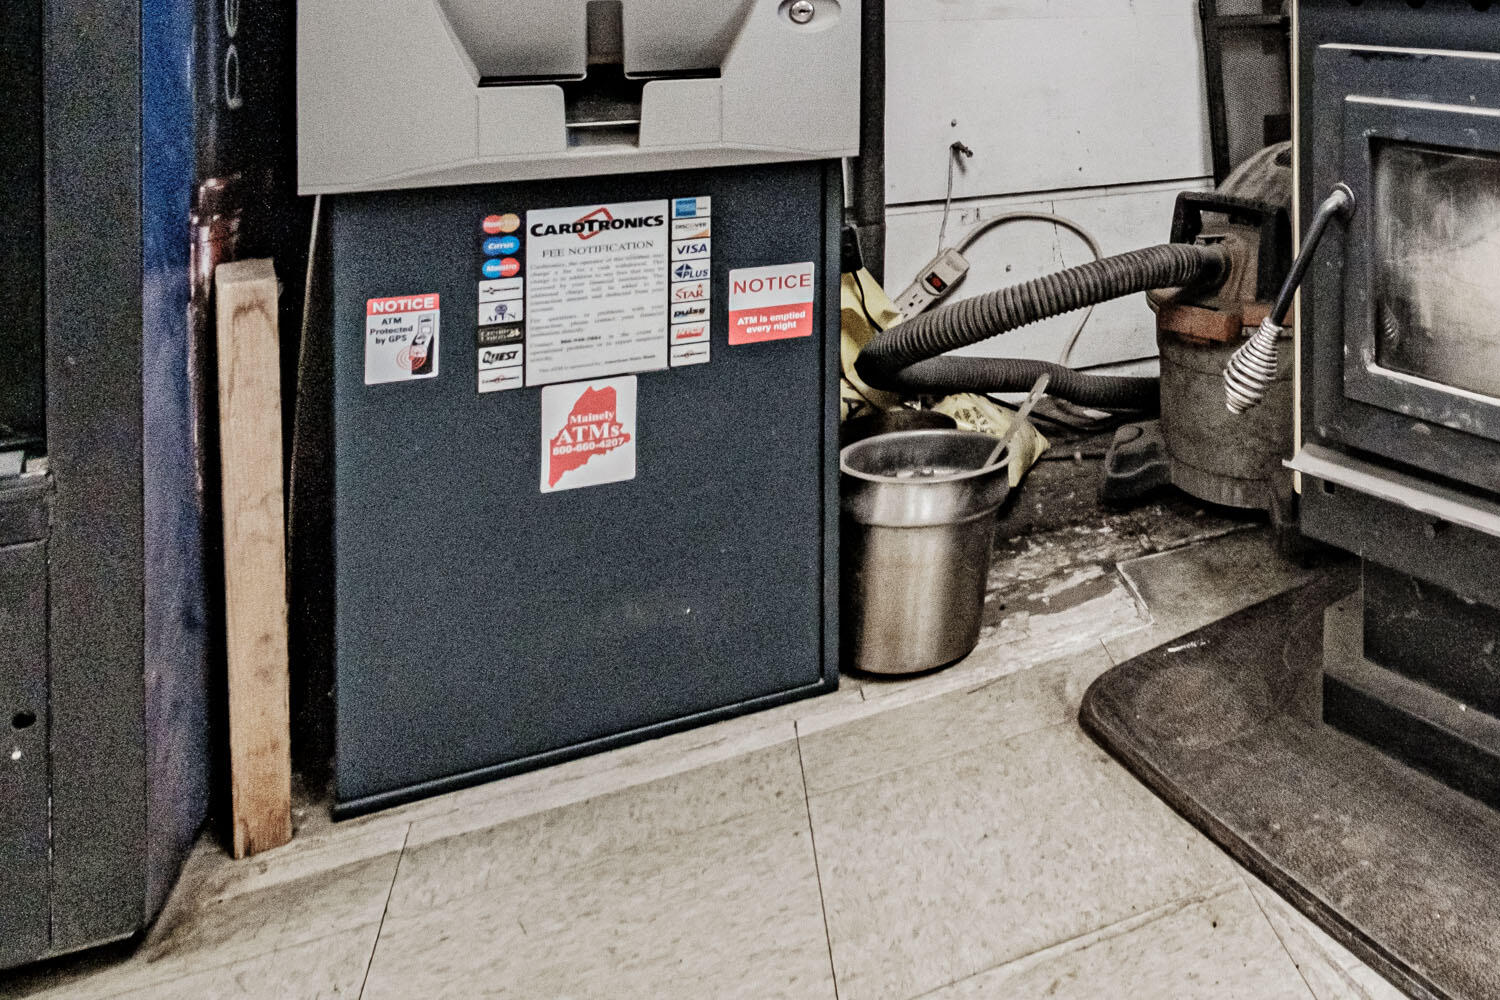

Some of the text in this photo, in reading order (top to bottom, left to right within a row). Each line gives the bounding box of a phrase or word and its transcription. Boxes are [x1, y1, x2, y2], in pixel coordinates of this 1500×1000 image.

[530, 215, 664, 237] CARDTRONICS
[488, 242, 514, 250] Cirrus
[542, 240, 654, 258] FEE NOTIFICATION
[677, 243, 707, 255] VISA
[486, 263, 517, 272] Maestro
[683, 269, 708, 279] PLUS
[734, 273, 811, 295] NOTICE
[675, 287, 704, 300] STAR
[372, 296, 435, 313] NOTICE
[382, 317, 402, 325] ATM
[737, 311, 806, 326] ATM is emptied
[370, 325, 413, 335] Protected
[746, 321, 796, 334] every night
[375, 335, 407, 345] by GPS
[482, 350, 519, 365] QUEST
[556, 422, 620, 446] ATMs
